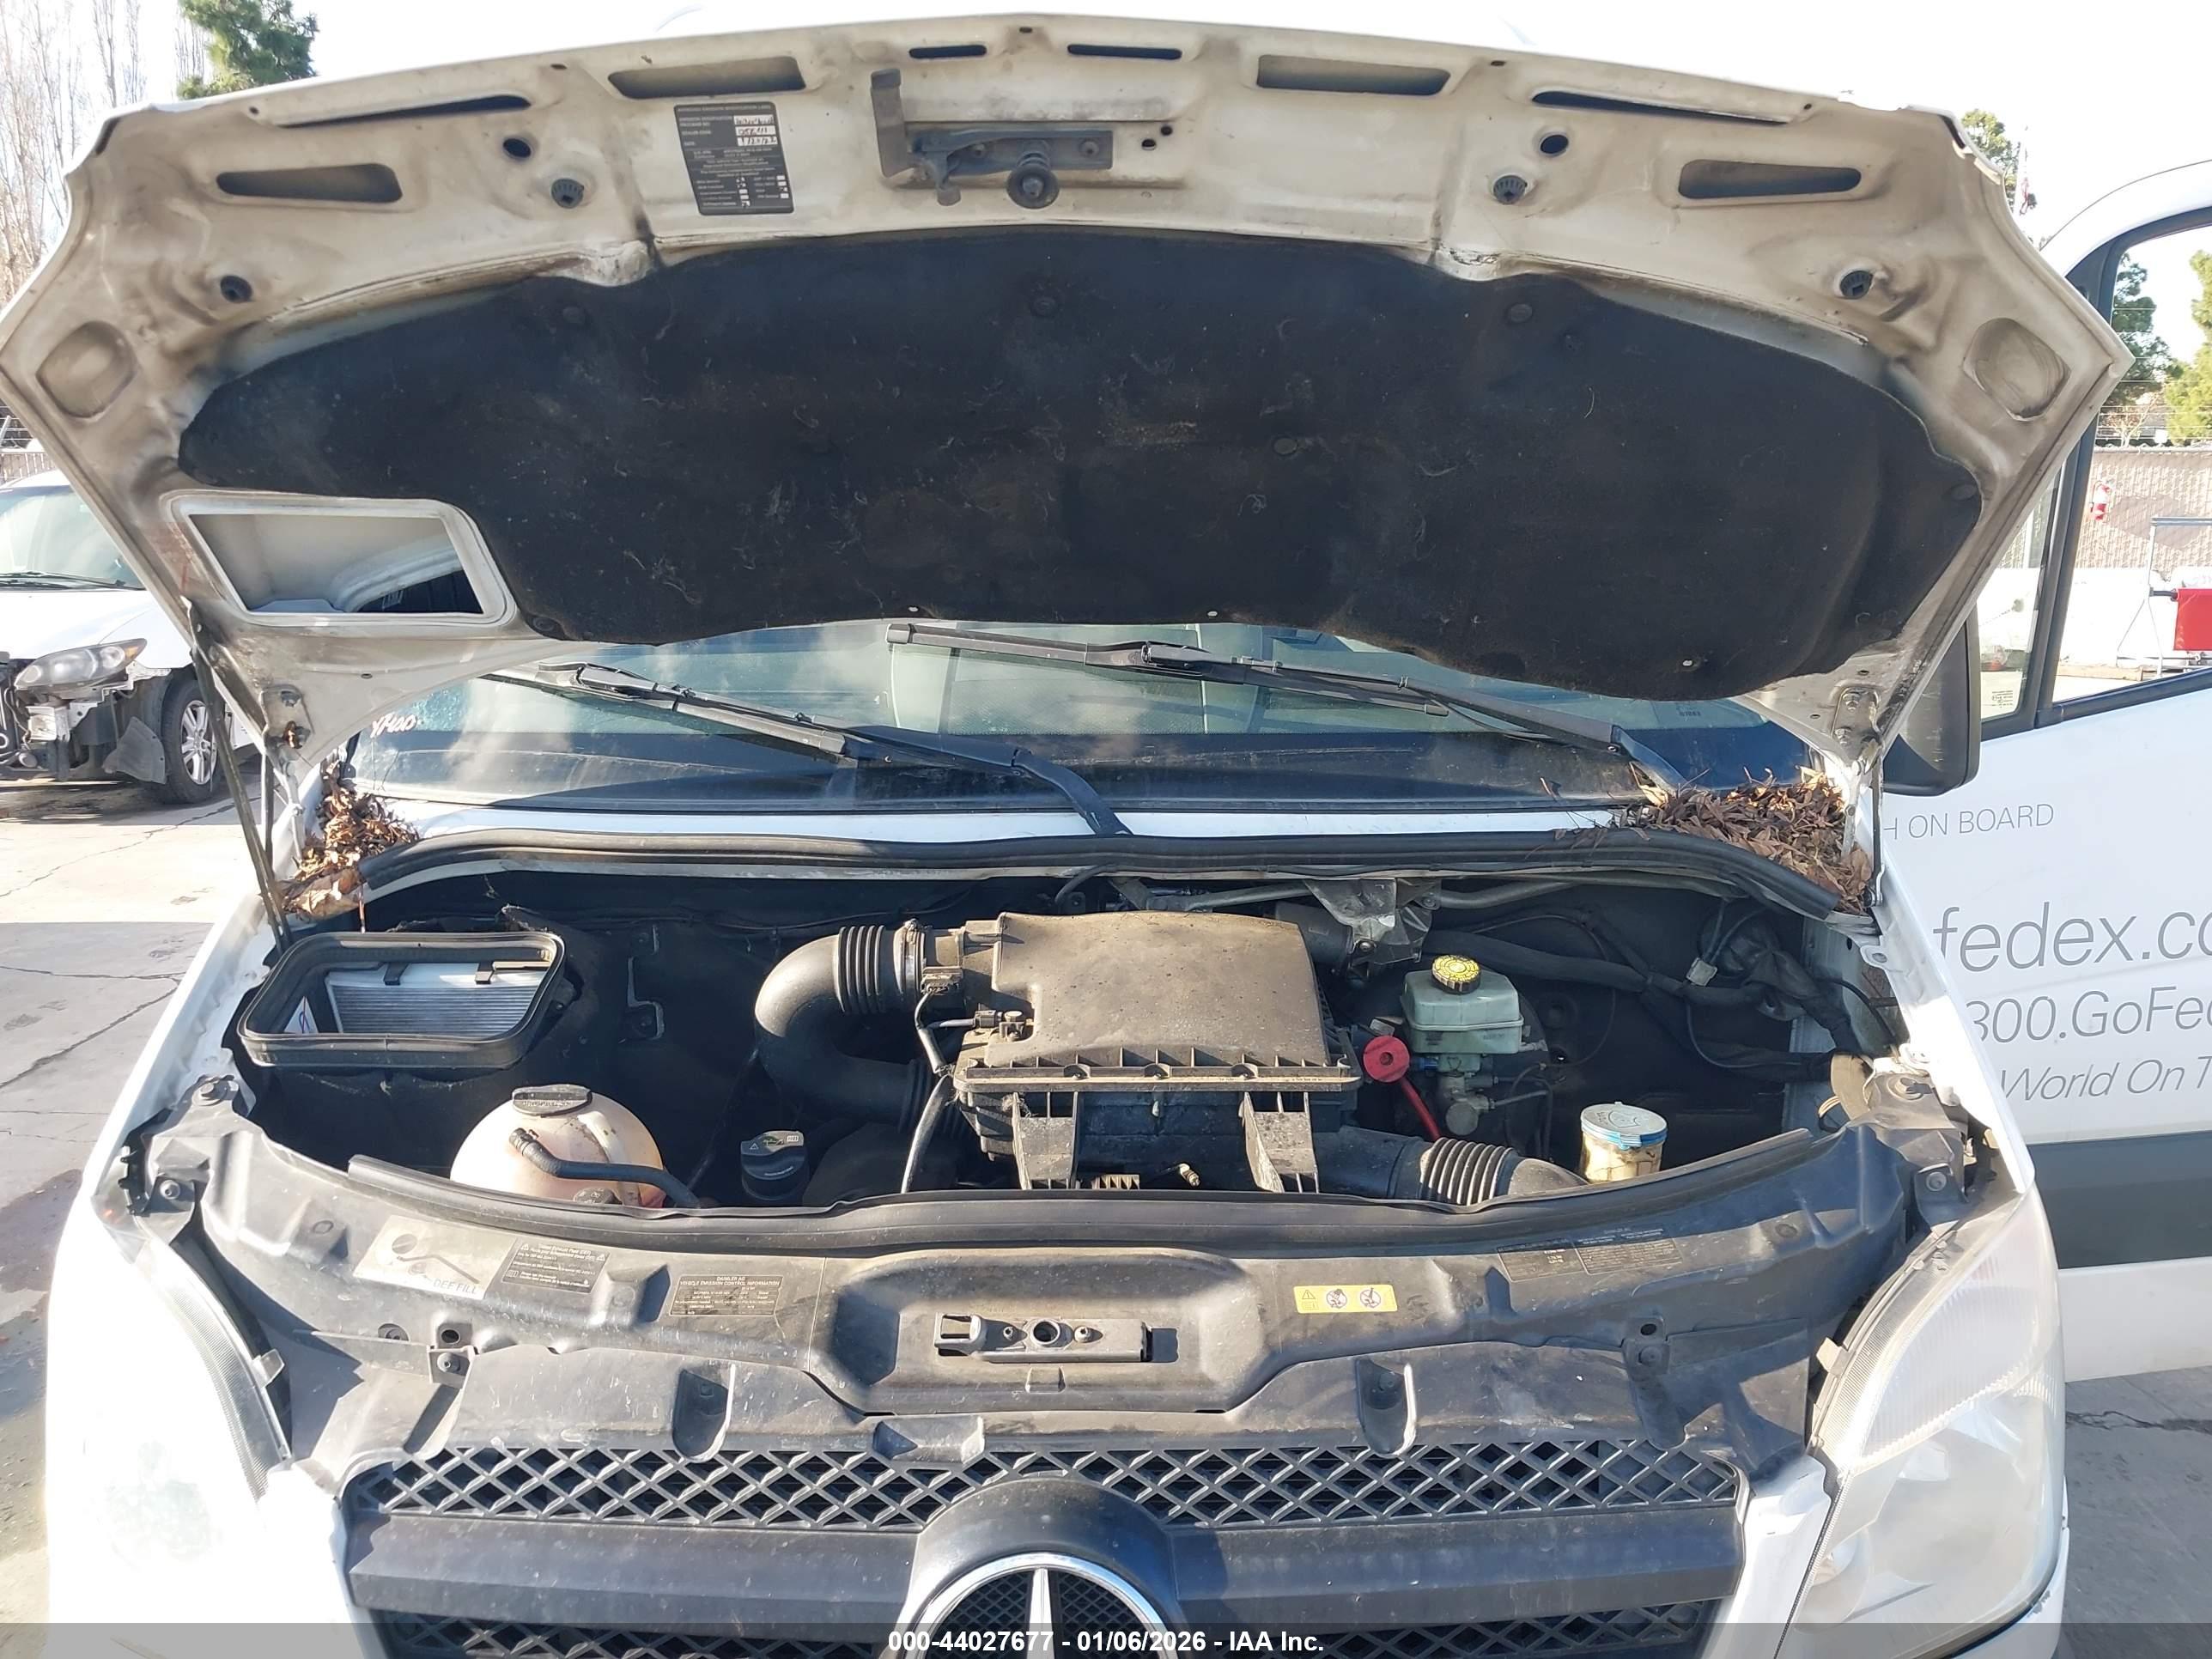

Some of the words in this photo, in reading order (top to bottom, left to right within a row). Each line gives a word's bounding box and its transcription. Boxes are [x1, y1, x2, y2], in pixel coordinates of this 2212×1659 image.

[1908, 812, 1949, 838] ON
[1959, 803, 2055, 834] BOARD
[1999, 1062, 2121, 1102] World
[2127, 1059, 2185, 1095] On
